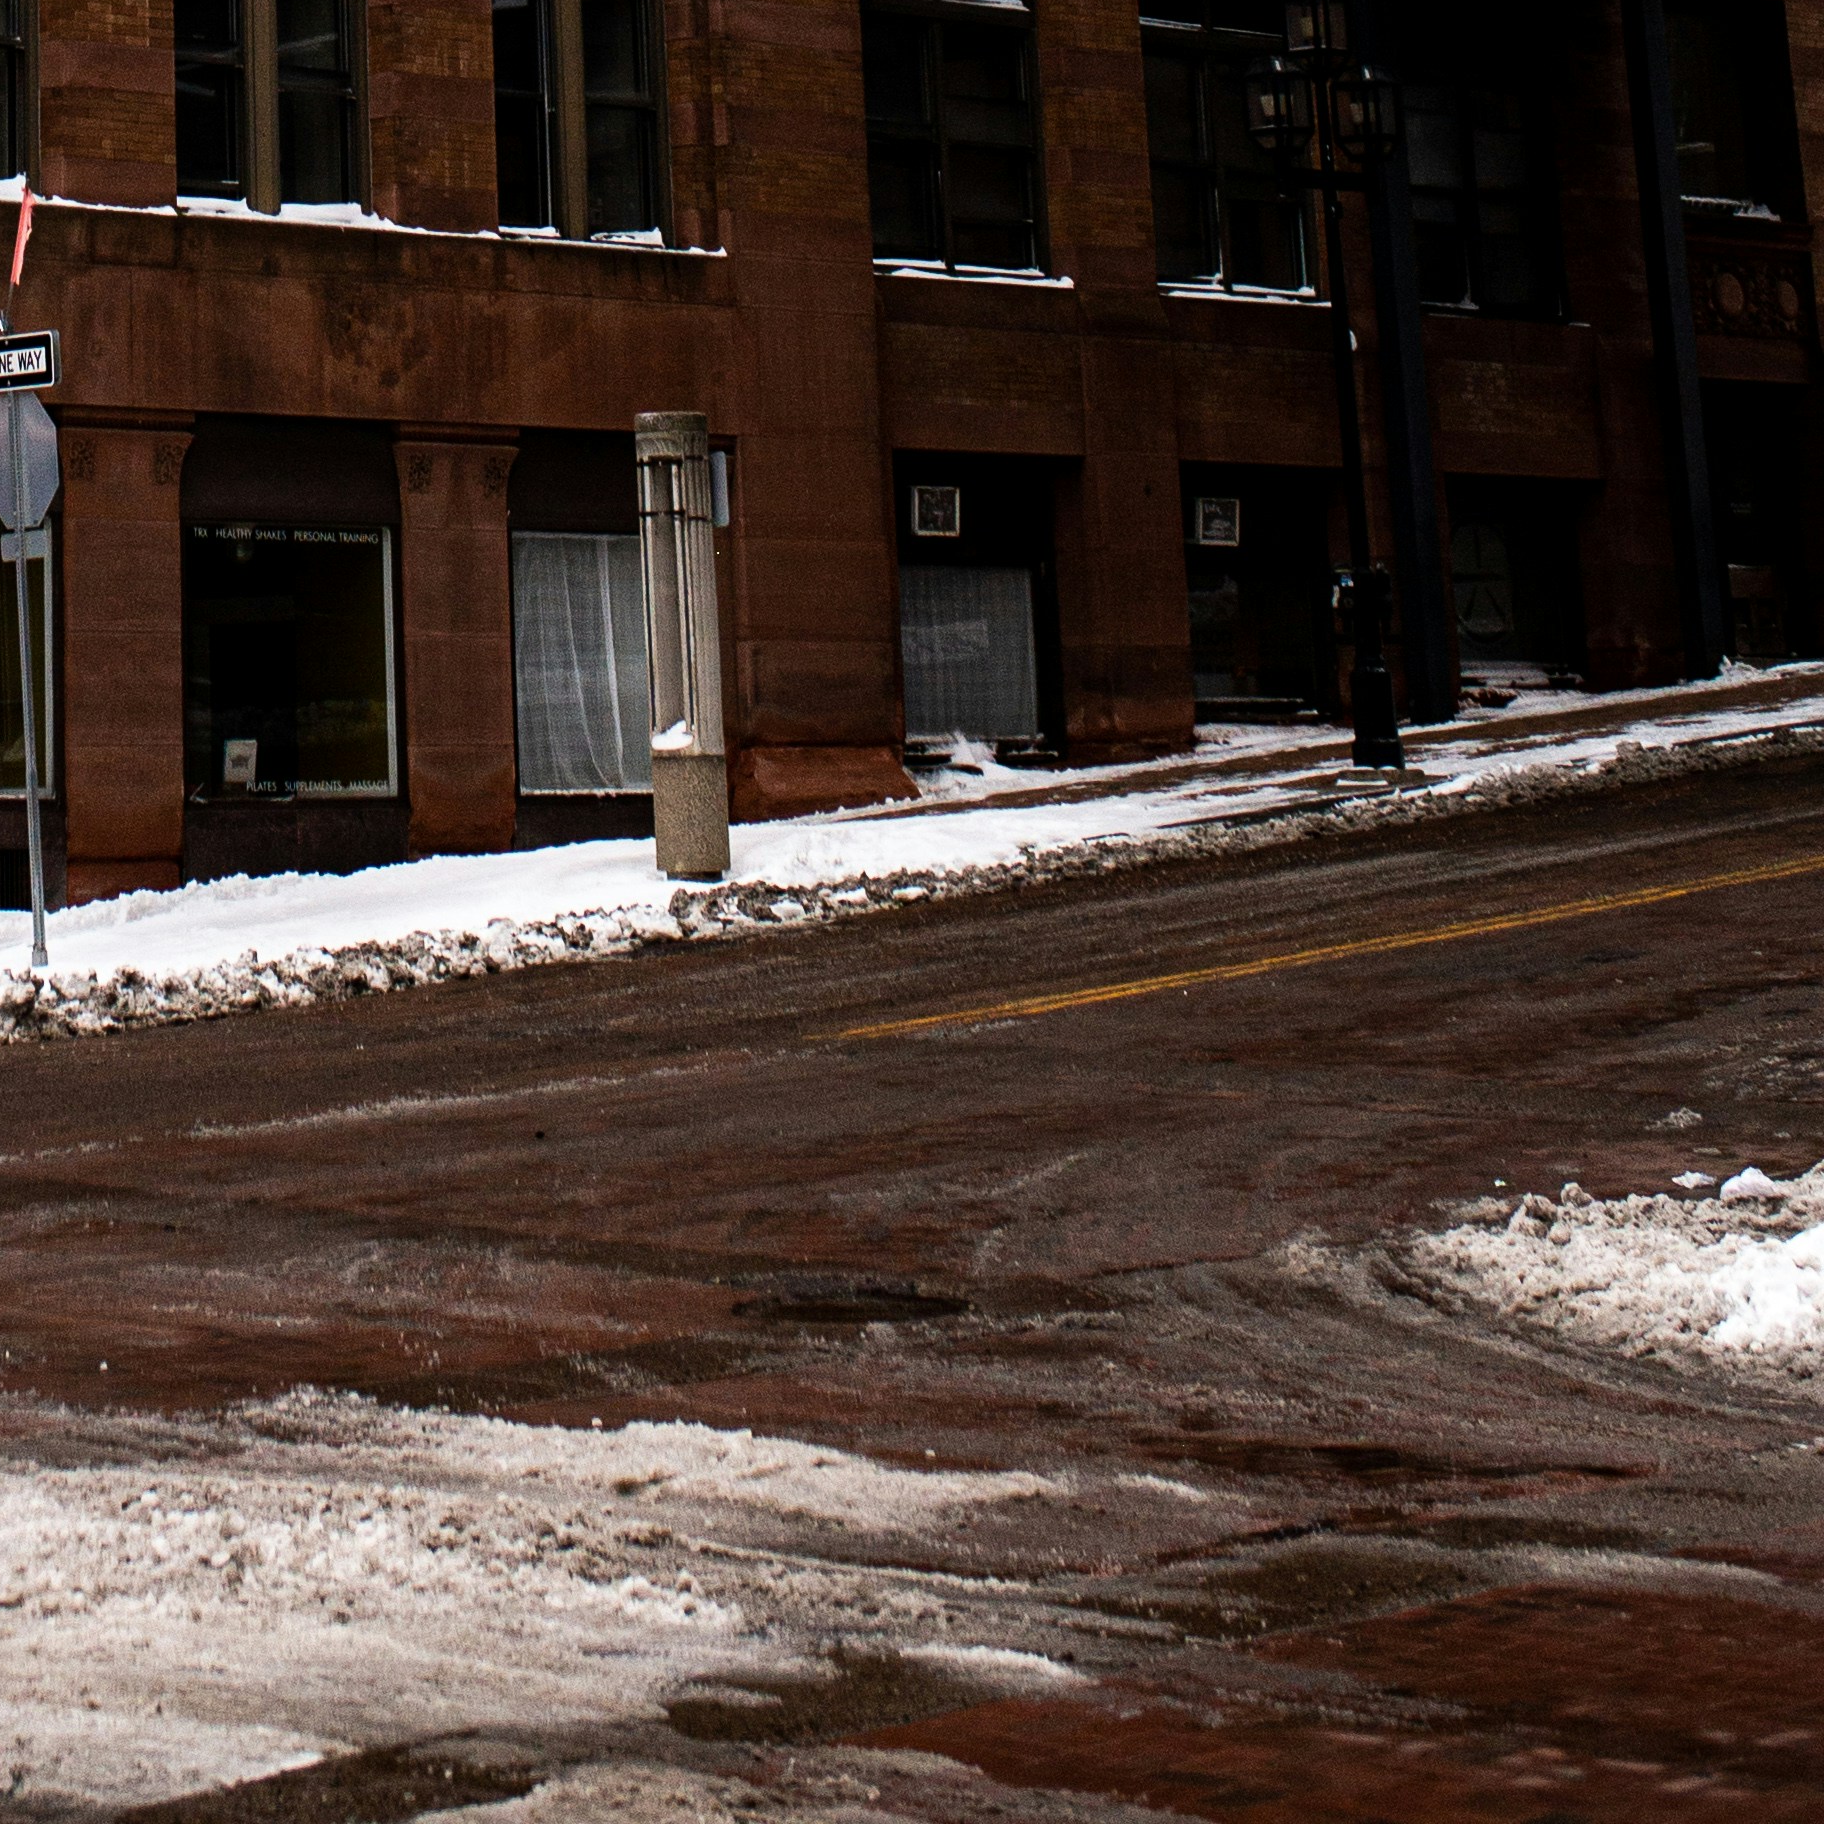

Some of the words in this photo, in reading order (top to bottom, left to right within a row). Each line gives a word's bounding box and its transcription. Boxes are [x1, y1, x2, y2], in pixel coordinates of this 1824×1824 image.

[18, 349, 42, 371] WAY
[192, 526, 209, 538] TRX
[215, 527, 252, 541] HEALTHY
[255, 529, 287, 542] SHAKES
[293, 530, 336, 543] PERSONAL
[338, 531, 379, 545] TRAINING
[246, 780, 277, 792] PILATES
[284, 780, 342, 792] SUPPLEMENTS
